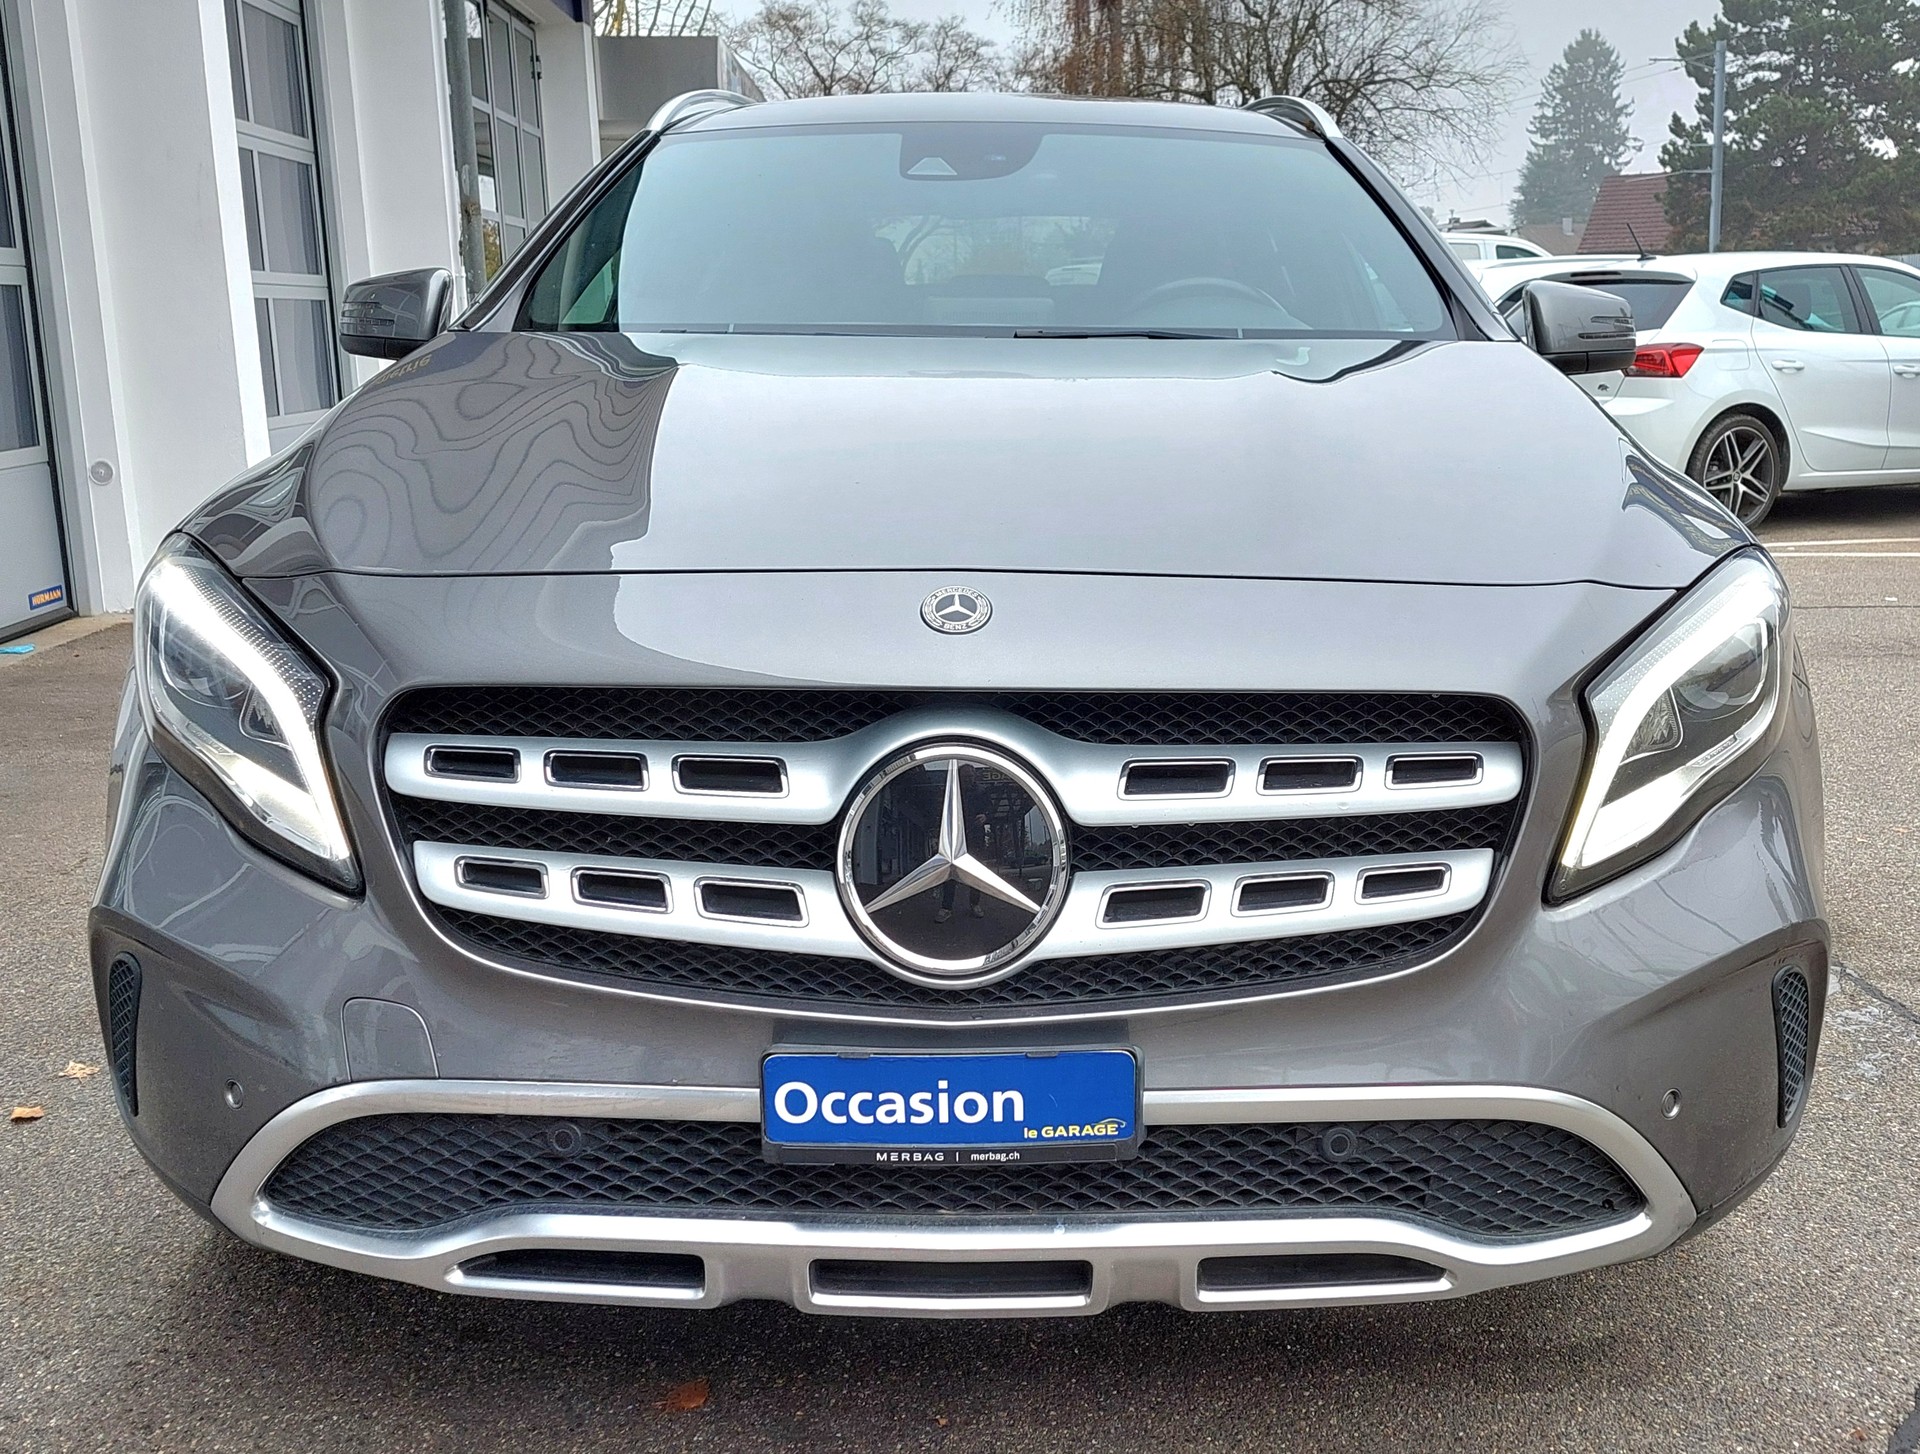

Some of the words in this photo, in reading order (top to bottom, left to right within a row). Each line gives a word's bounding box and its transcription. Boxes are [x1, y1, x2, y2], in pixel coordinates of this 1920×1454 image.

[935, 587, 978, 597] MERCEDES
[943, 622, 968, 630] BENZ
[774, 1080, 1024, 1124] Occasion
[1024, 1127, 1038, 1139] le
[1041, 1123, 1119, 1138] GARAGE
[876, 1152, 945, 1162] MERBAG
[970, 1151, 1020, 1163] merbag.ch
